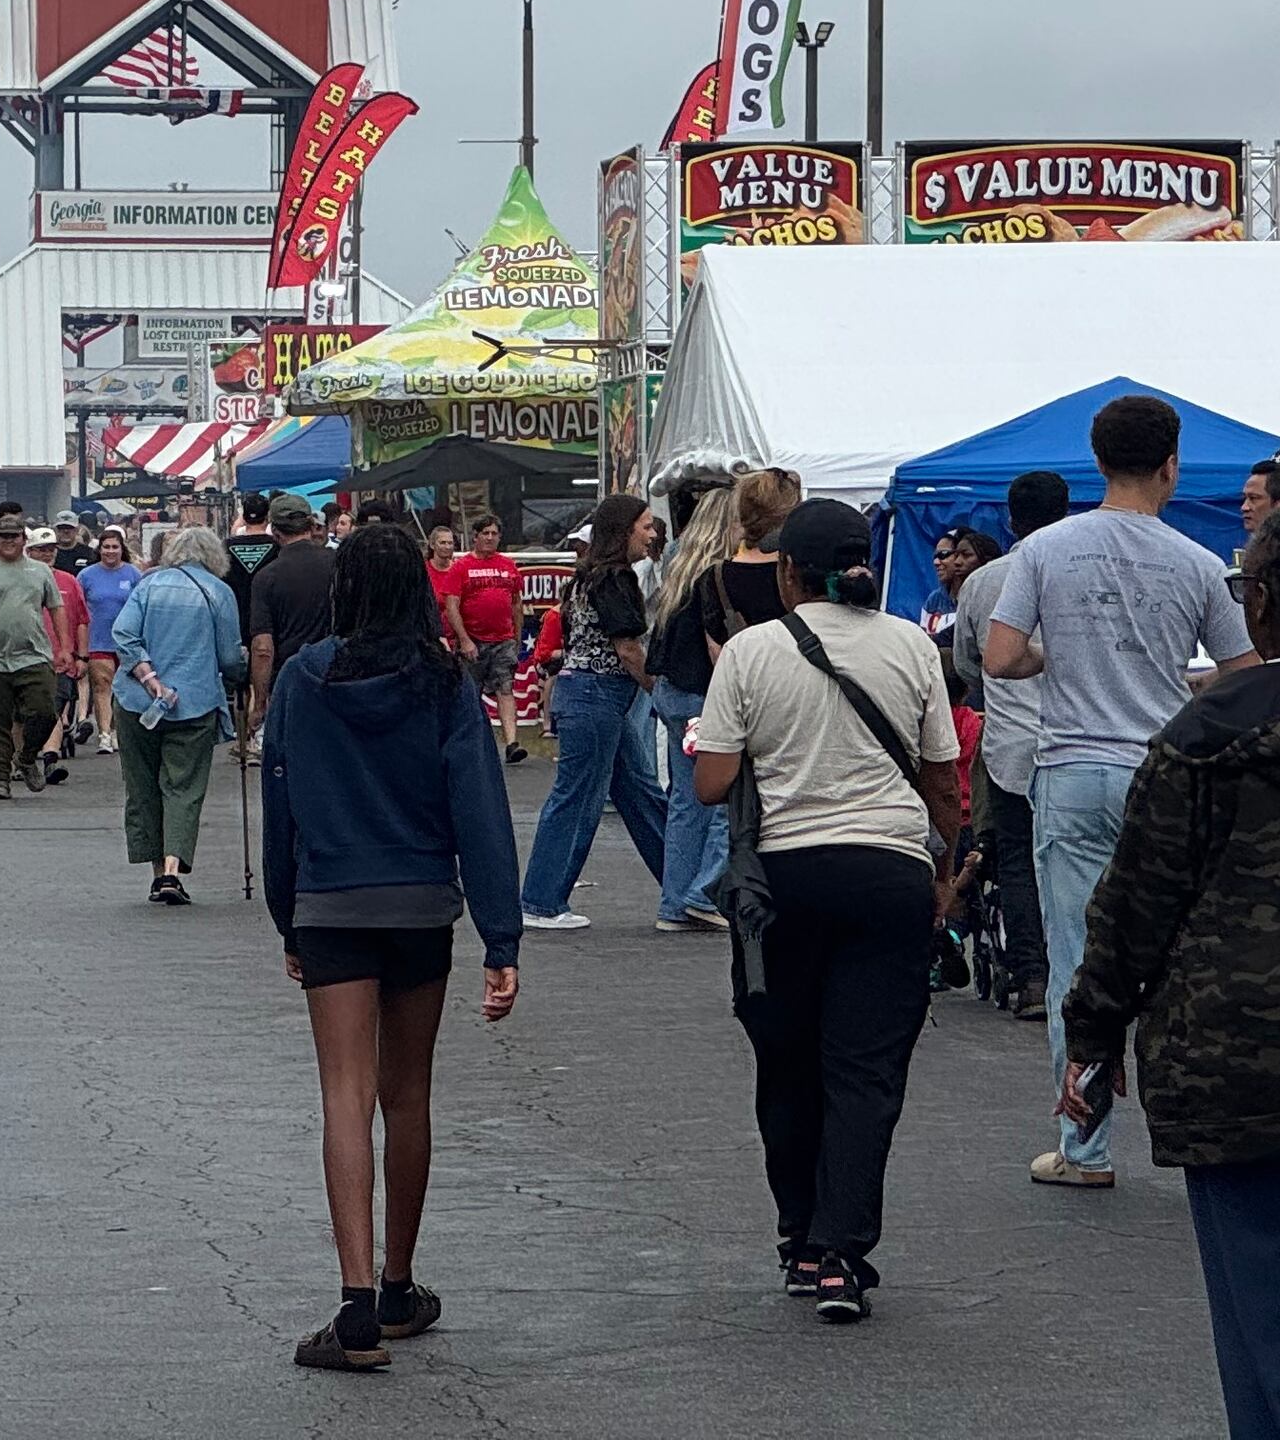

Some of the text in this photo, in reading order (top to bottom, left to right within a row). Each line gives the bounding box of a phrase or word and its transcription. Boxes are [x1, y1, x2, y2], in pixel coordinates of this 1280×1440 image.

[289, 83, 346, 216] BELTS
[314, 119, 384, 220] HATS
[710, 153, 834, 185] VALUE
[719, 180, 823, 209] MENU
[924, 156, 1219, 213] $ VALUE MENU
[50, 198, 103, 227] Georgia
[113, 205, 238, 225] INFORMATION
[243, 205, 278, 225] CEN
[734, 216, 838, 246] CHOS
[931, 214, 1047, 244] CHOS
[479, 237, 569, 271] Fresh
[495, 267, 584, 282] SQUEEZED
[143, 331, 227, 340] LOST CHILDREN
[146, 319, 224, 329] INFORMATION
[320, 373, 372, 398] Fresh
[404, 373, 448, 394] ICE
[526, 372, 598, 393] LEMO
[370, 400, 426, 426] Fresh
[451, 400, 599, 441] LEMONAD
[380, 417, 440, 440] SQUEEZED
[521, 574, 553, 601] LUE
